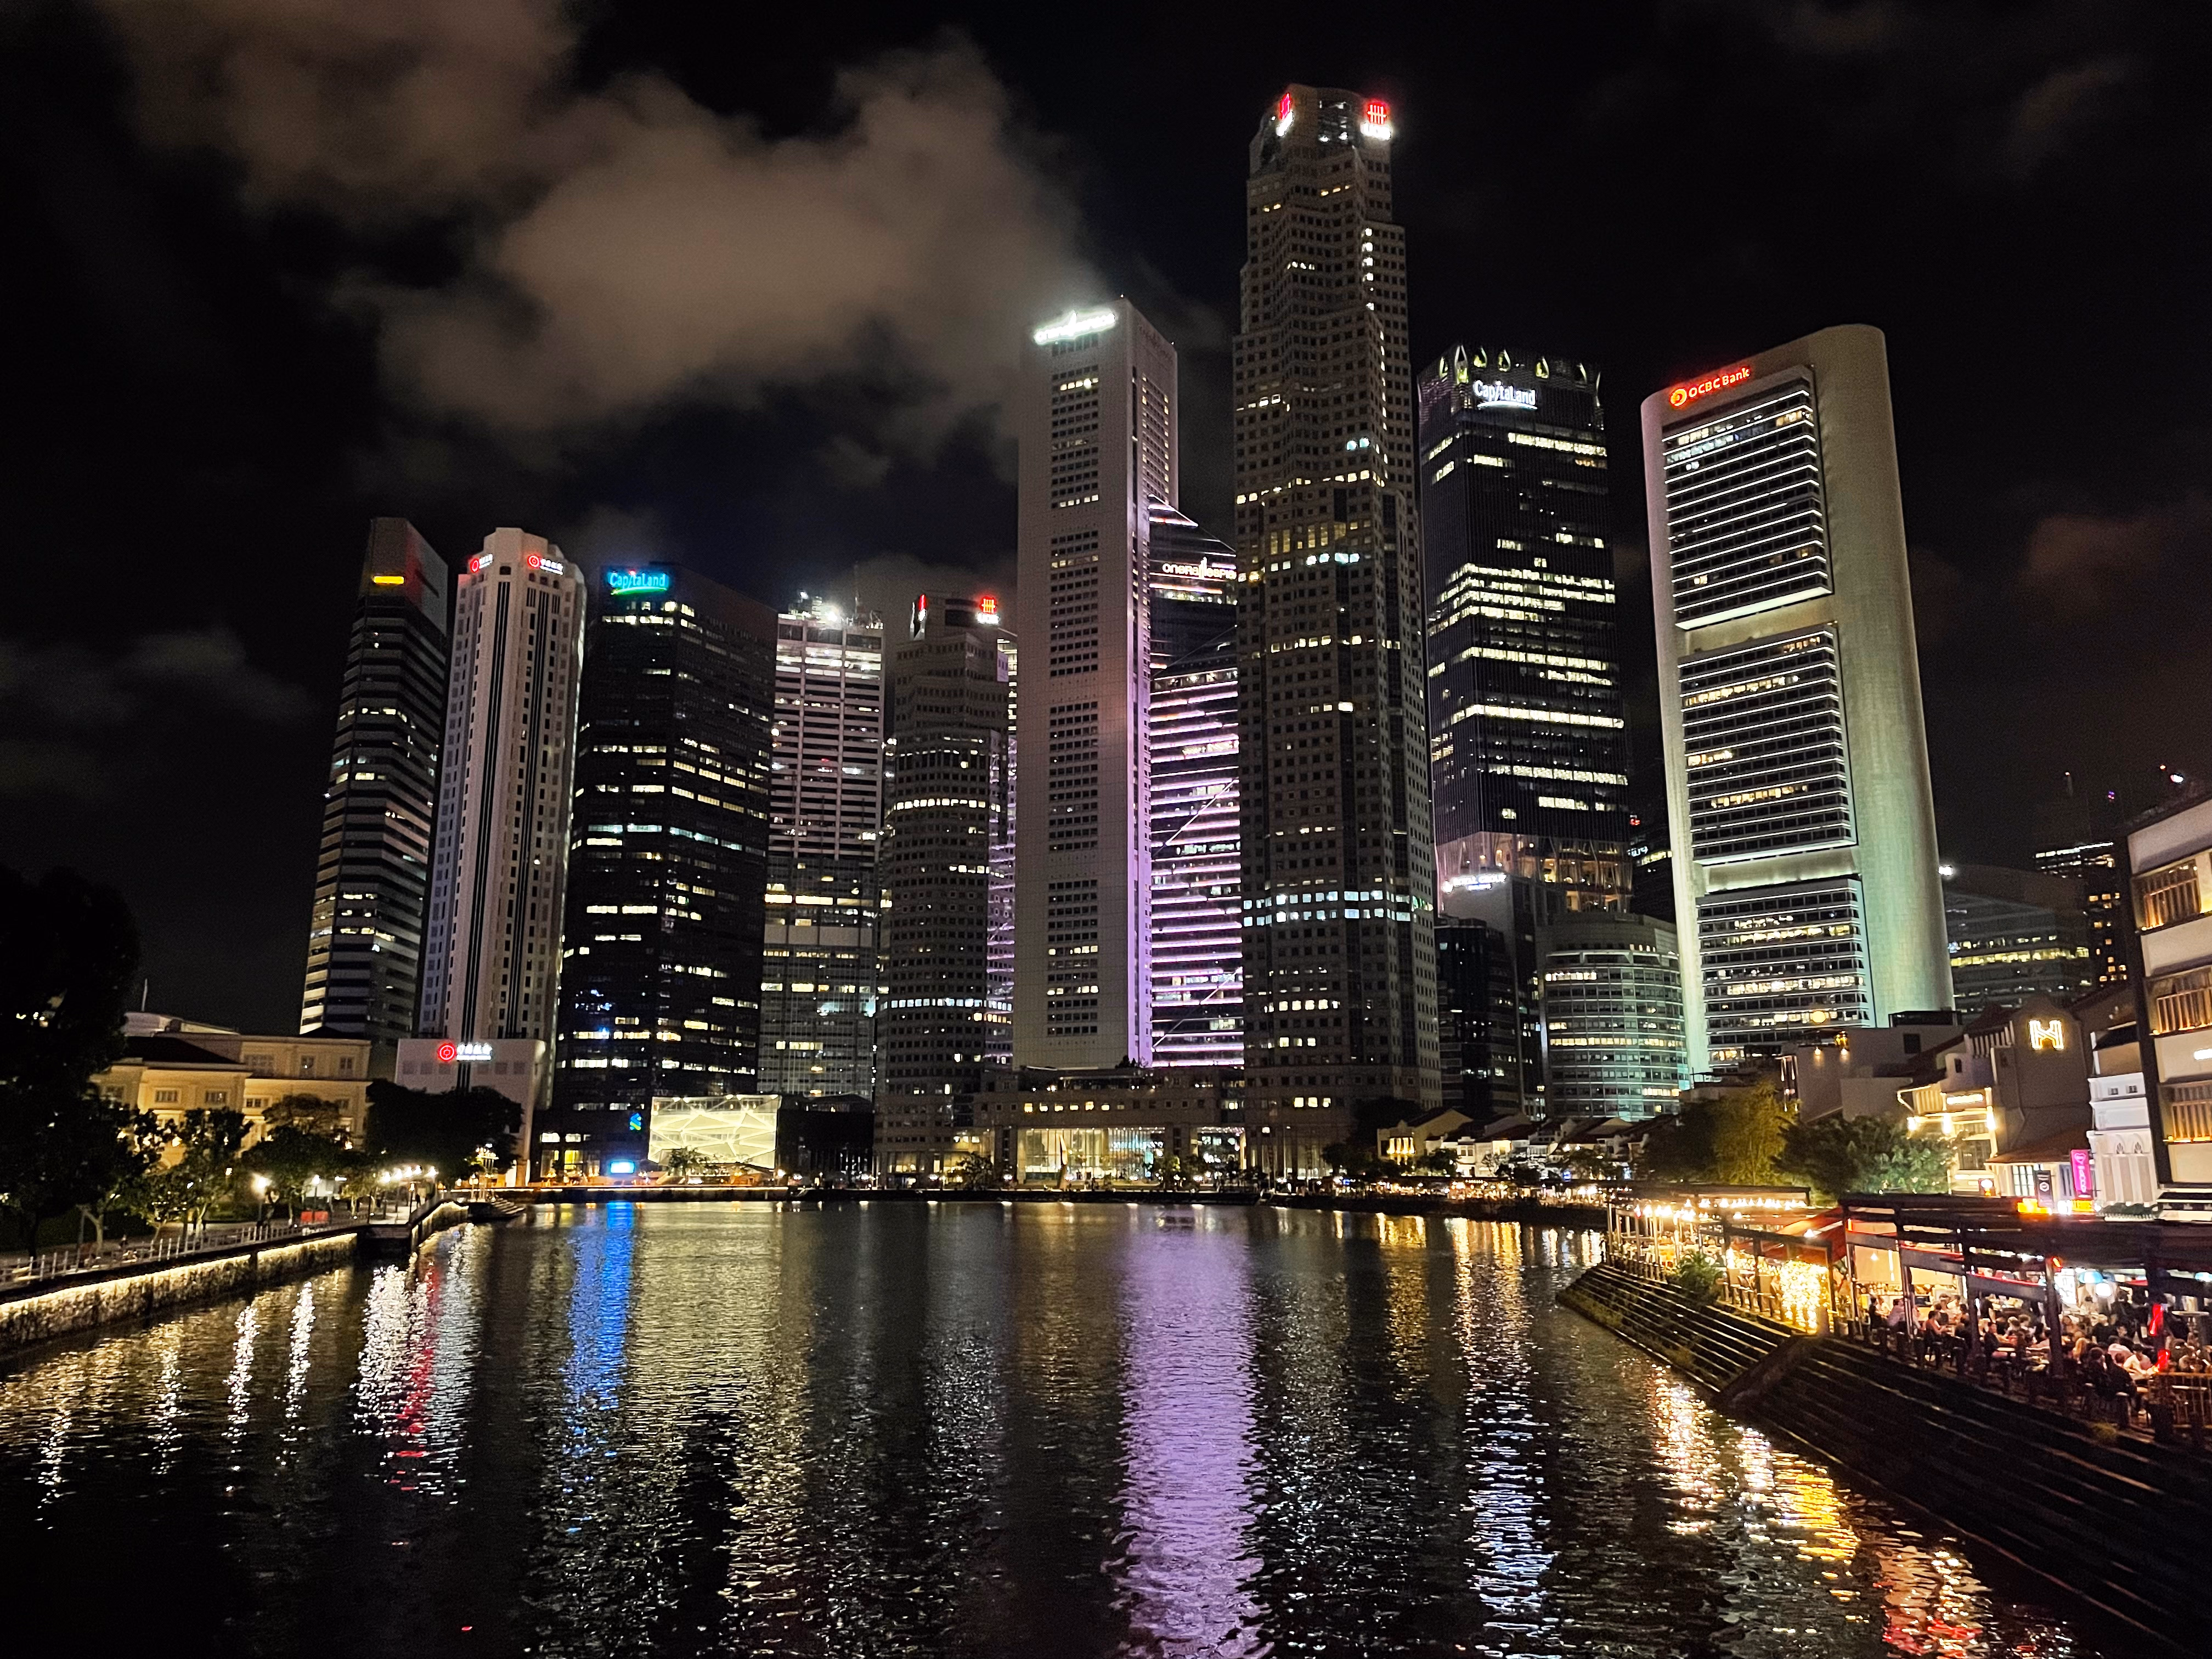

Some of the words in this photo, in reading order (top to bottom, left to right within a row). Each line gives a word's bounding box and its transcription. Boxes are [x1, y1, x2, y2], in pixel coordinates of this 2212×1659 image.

[1473, 380, 1536, 405] CapitaLand
[1689, 377, 1720, 398] OCBC
[1722, 368, 1750, 386] Bank
[610, 571, 666, 589] CapitaLand
